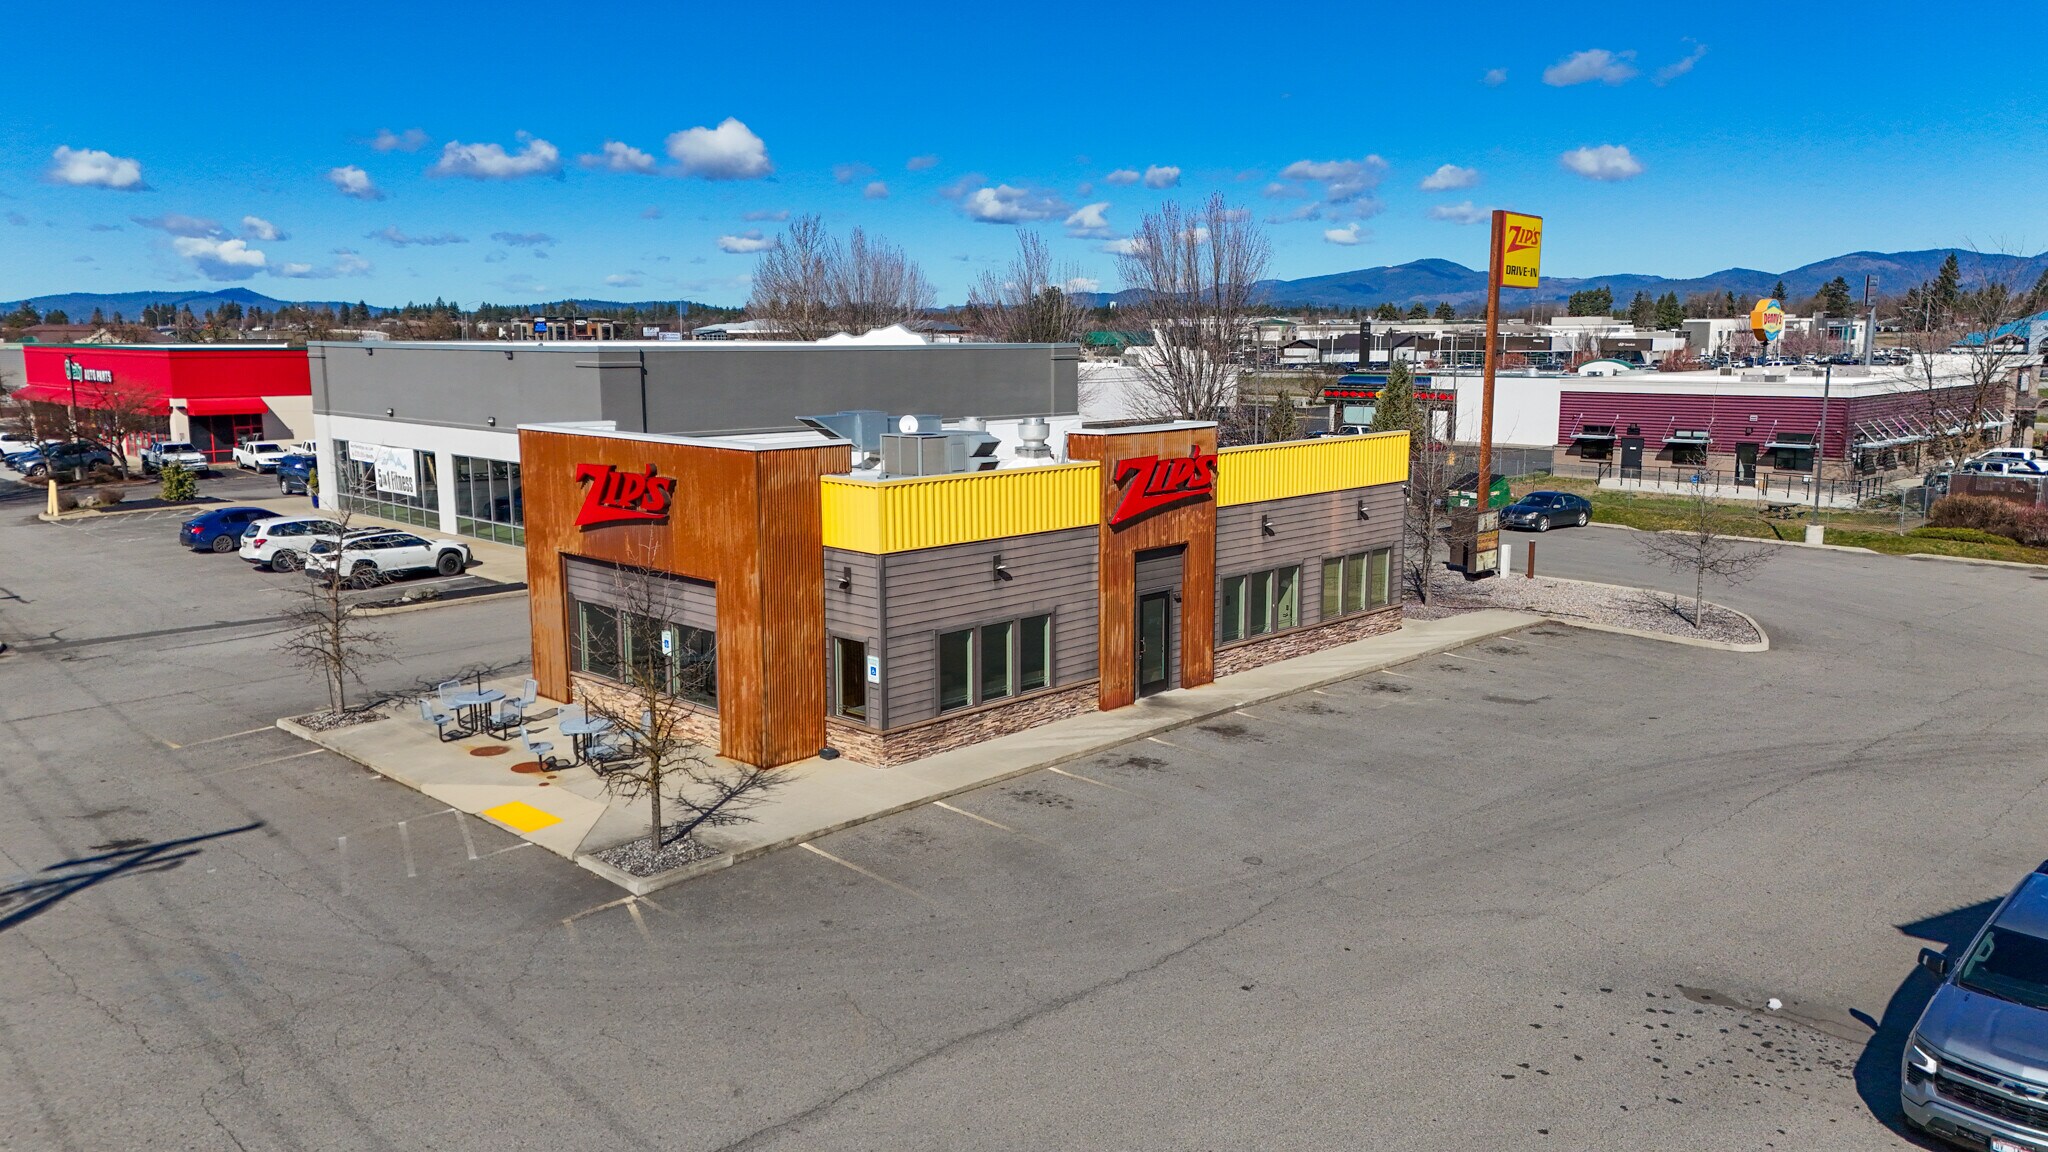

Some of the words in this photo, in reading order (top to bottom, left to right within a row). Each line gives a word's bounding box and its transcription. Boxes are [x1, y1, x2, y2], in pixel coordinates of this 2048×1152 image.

[1506, 265, 1537, 277] DRIVE-IN
[1763, 312, 1783, 326] Denny's
[96, 370, 112, 383] PARTS
[391, 471, 414, 493] Fitness
